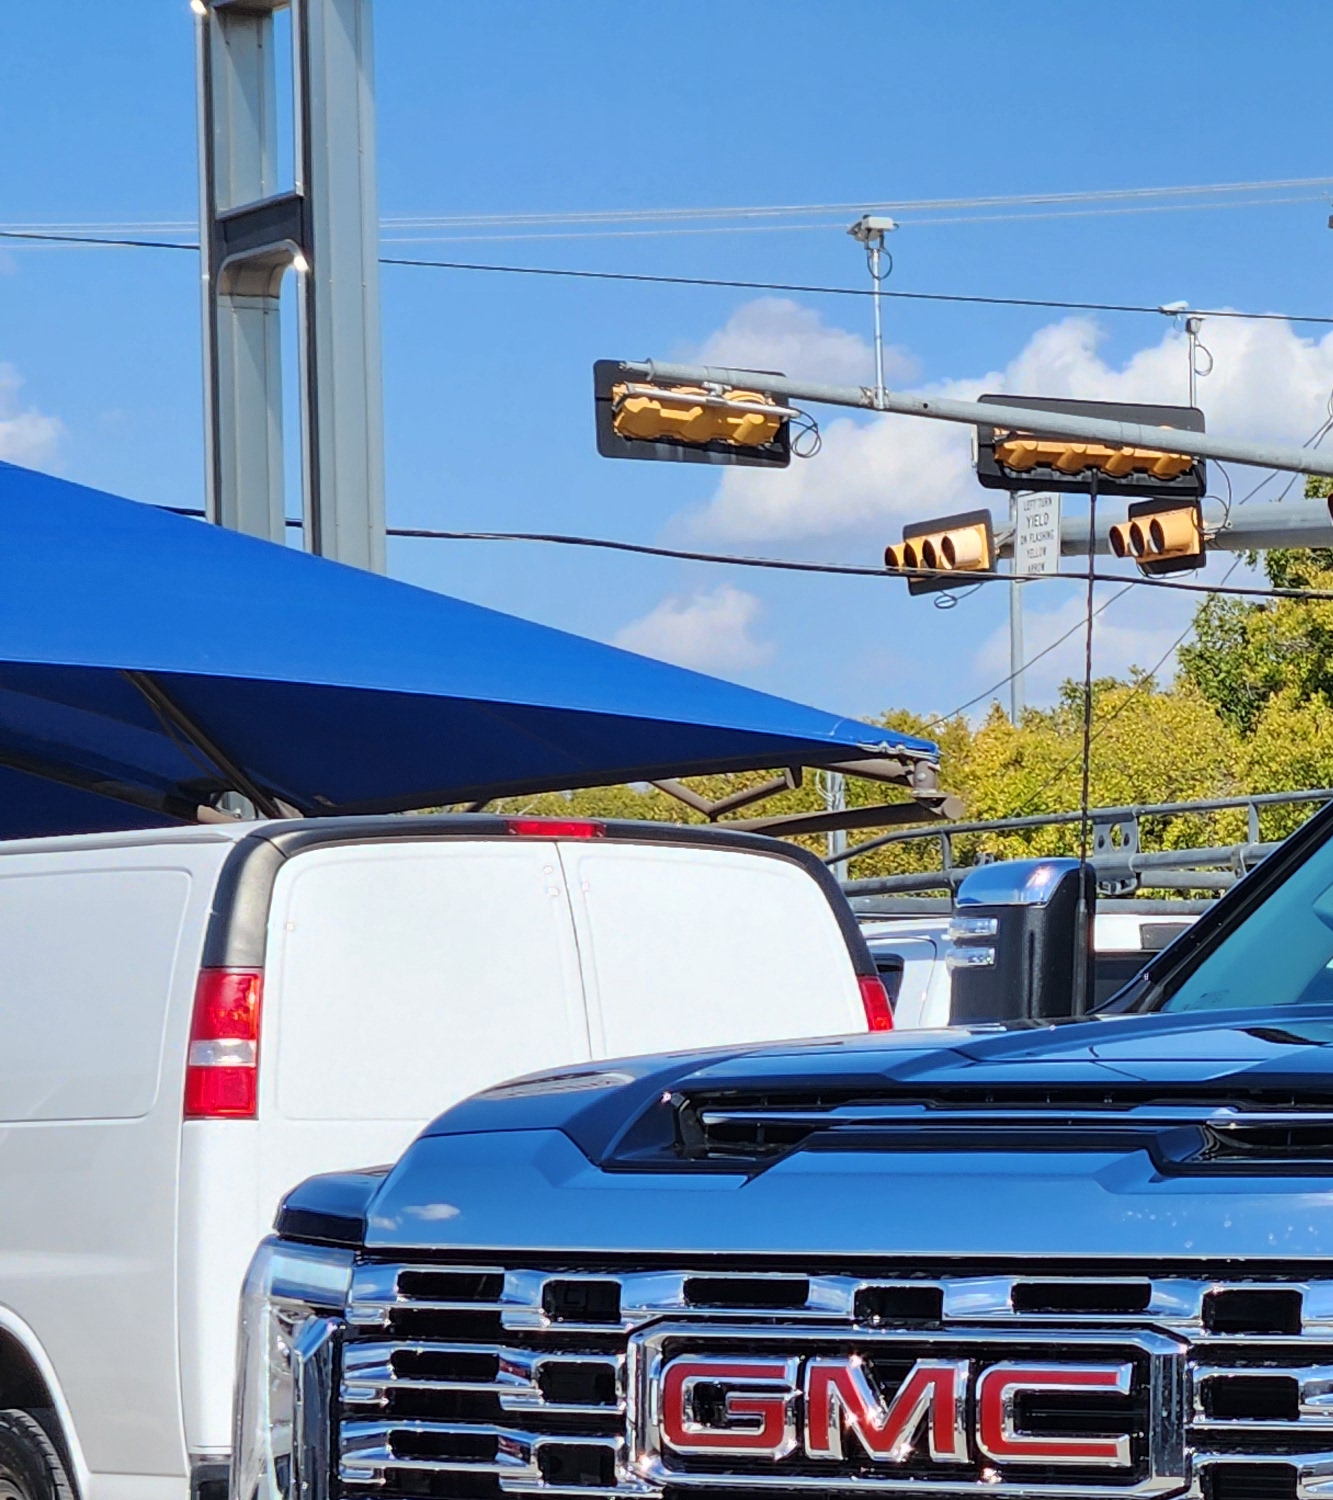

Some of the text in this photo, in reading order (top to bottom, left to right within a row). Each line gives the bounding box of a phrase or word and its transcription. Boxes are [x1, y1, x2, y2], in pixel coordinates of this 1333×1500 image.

[1024, 497, 1052, 511] LEFT TURN
[1026, 512, 1050, 529] YIELD
[1020, 529, 1055, 546] ON FLASHING
[1027, 546, 1047, 559] YELLOW
[659, 1353, 1135, 1467] GMC
